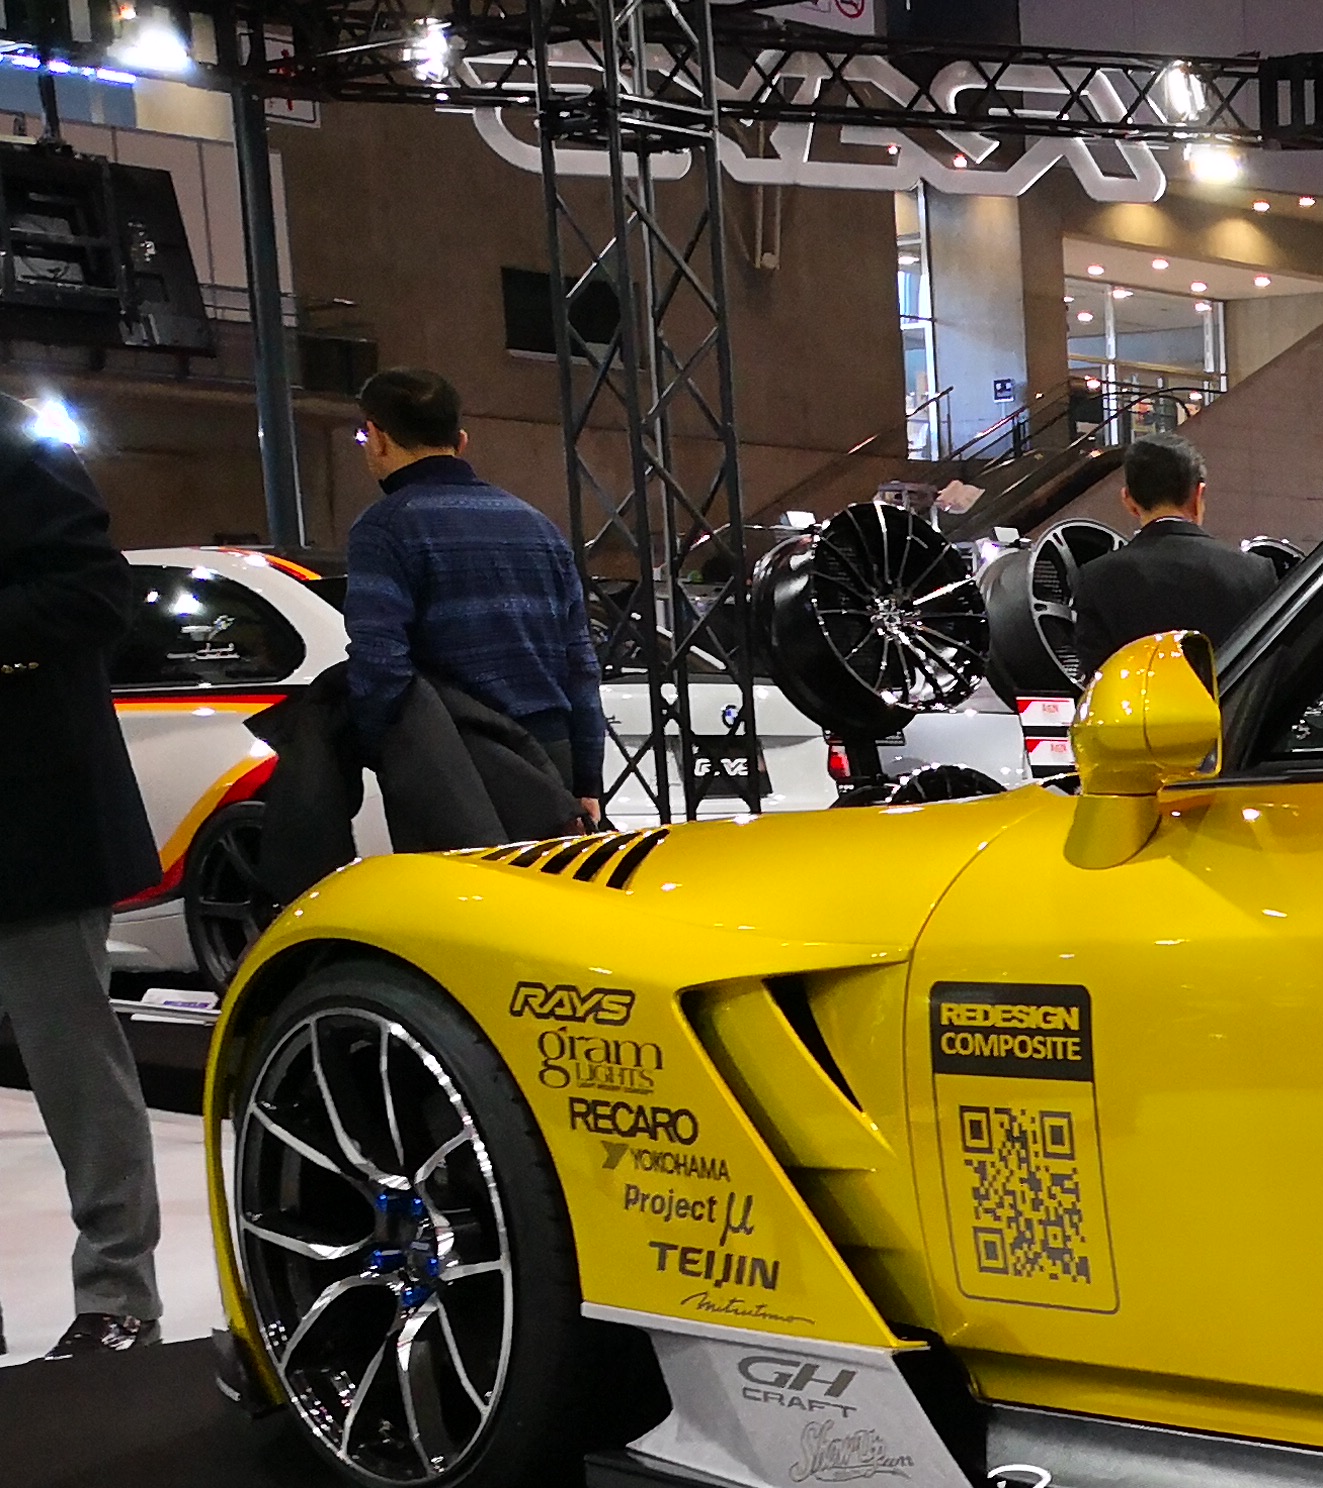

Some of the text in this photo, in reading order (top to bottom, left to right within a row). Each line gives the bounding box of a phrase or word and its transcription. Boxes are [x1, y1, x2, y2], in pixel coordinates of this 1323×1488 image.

[510, 981, 635, 1026] RAYS
[940, 1003, 1080, 1030] REDESIGN
[538, 1026, 664, 1089] gram
[941, 1032, 1082, 1061] COMPOSITE
[569, 1097, 698, 1146] RECARO
[630, 1149, 731, 1182] YOKOHAMA
[624, 1183, 717, 1223] Project
[648, 1241, 780, 1291] TEIJIN
[737, 1356, 857, 1398] GH
[742, 1387, 857, 1418] CRAFT
